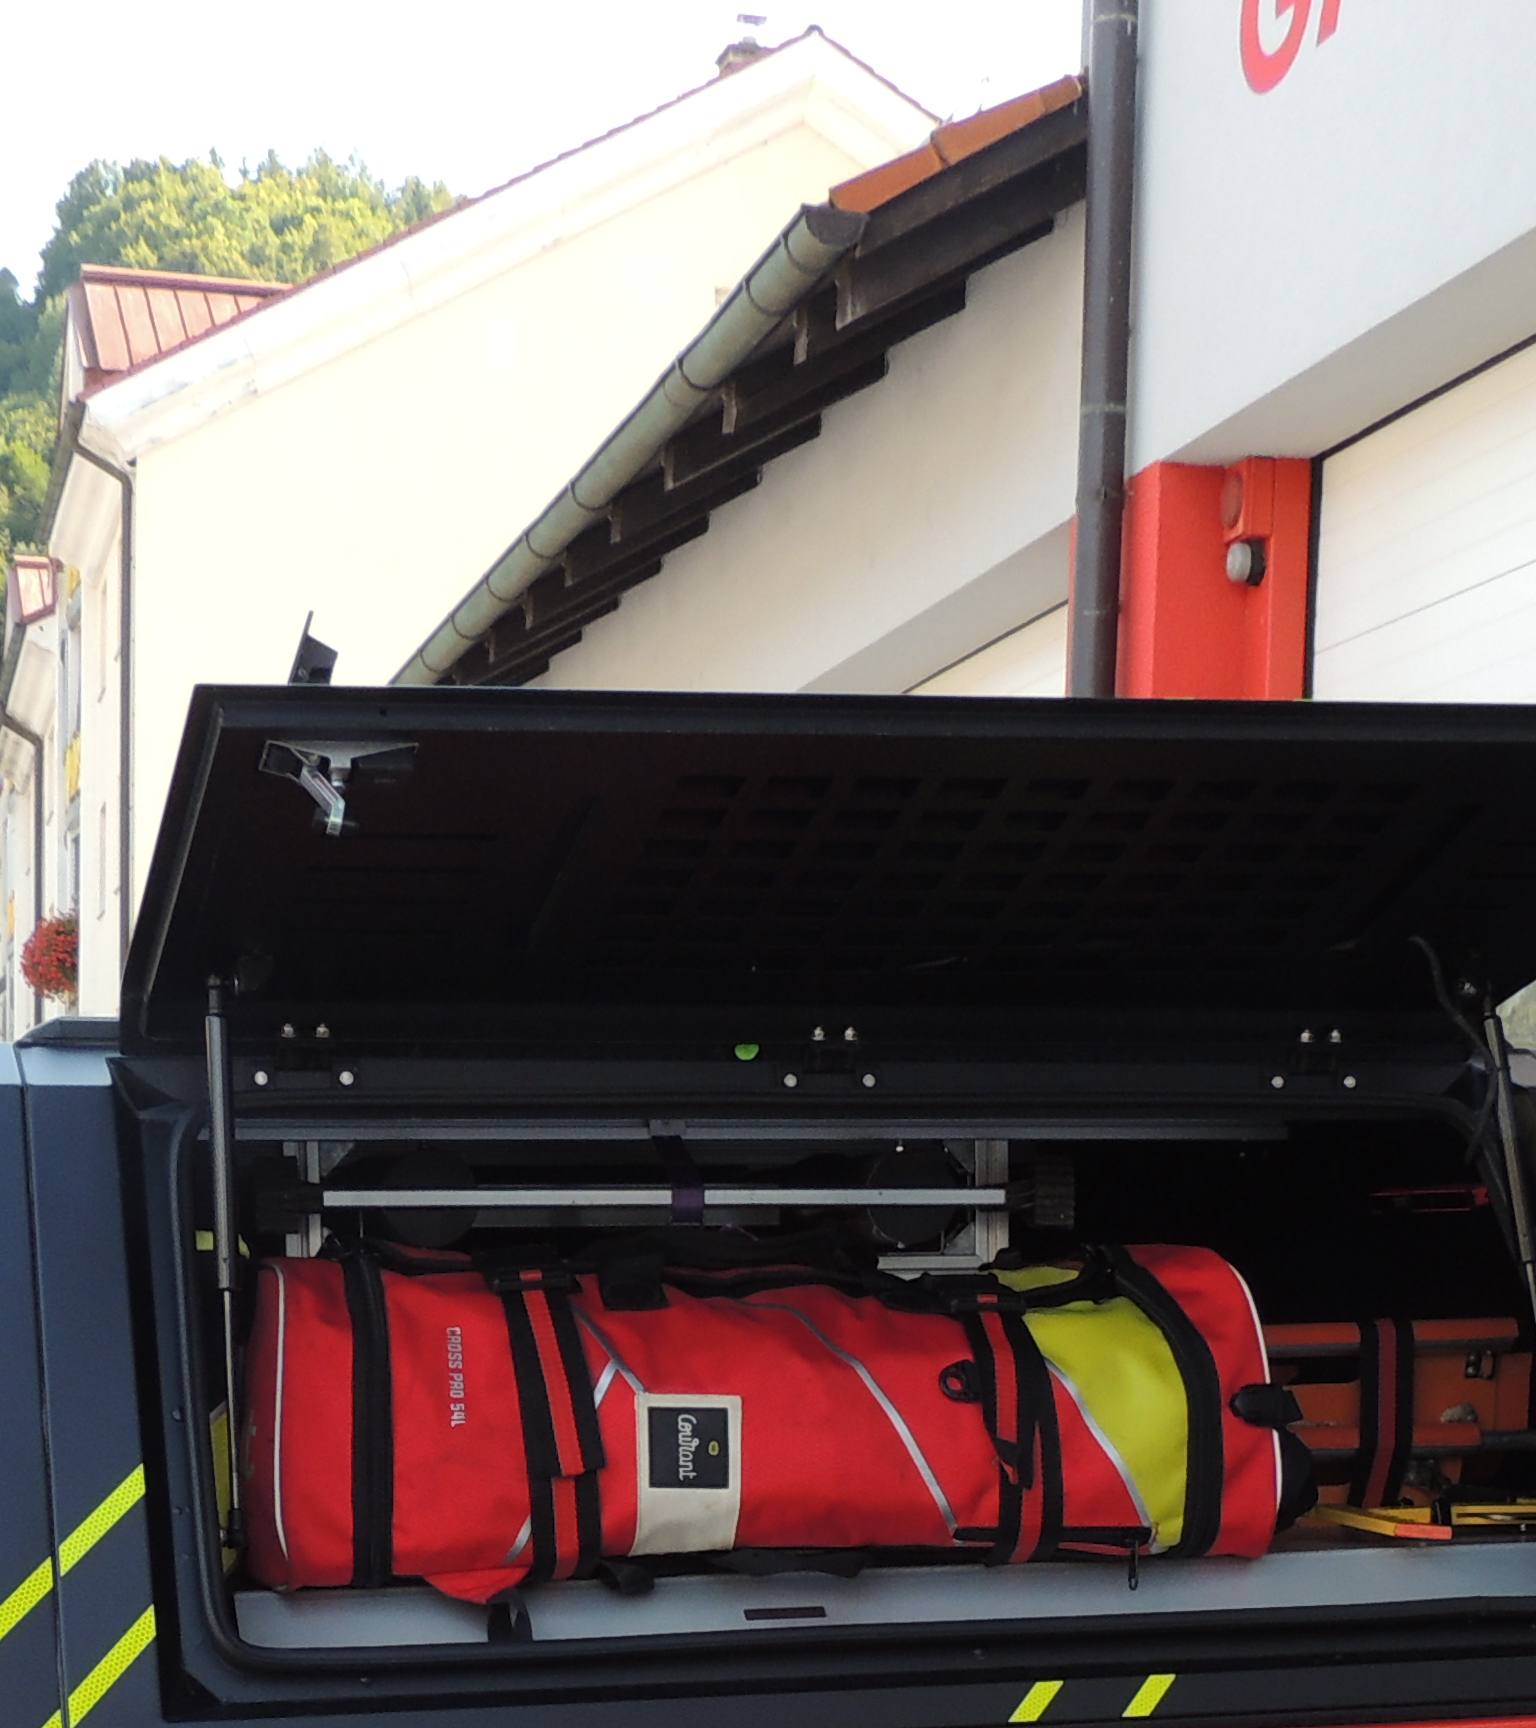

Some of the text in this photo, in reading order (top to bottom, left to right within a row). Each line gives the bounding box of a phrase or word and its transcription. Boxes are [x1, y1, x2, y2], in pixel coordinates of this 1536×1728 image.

[446, 1326, 463, 1369] CROSS
[449, 1372, 465, 1399] PRO
[677, 1414, 699, 1481] Courant
